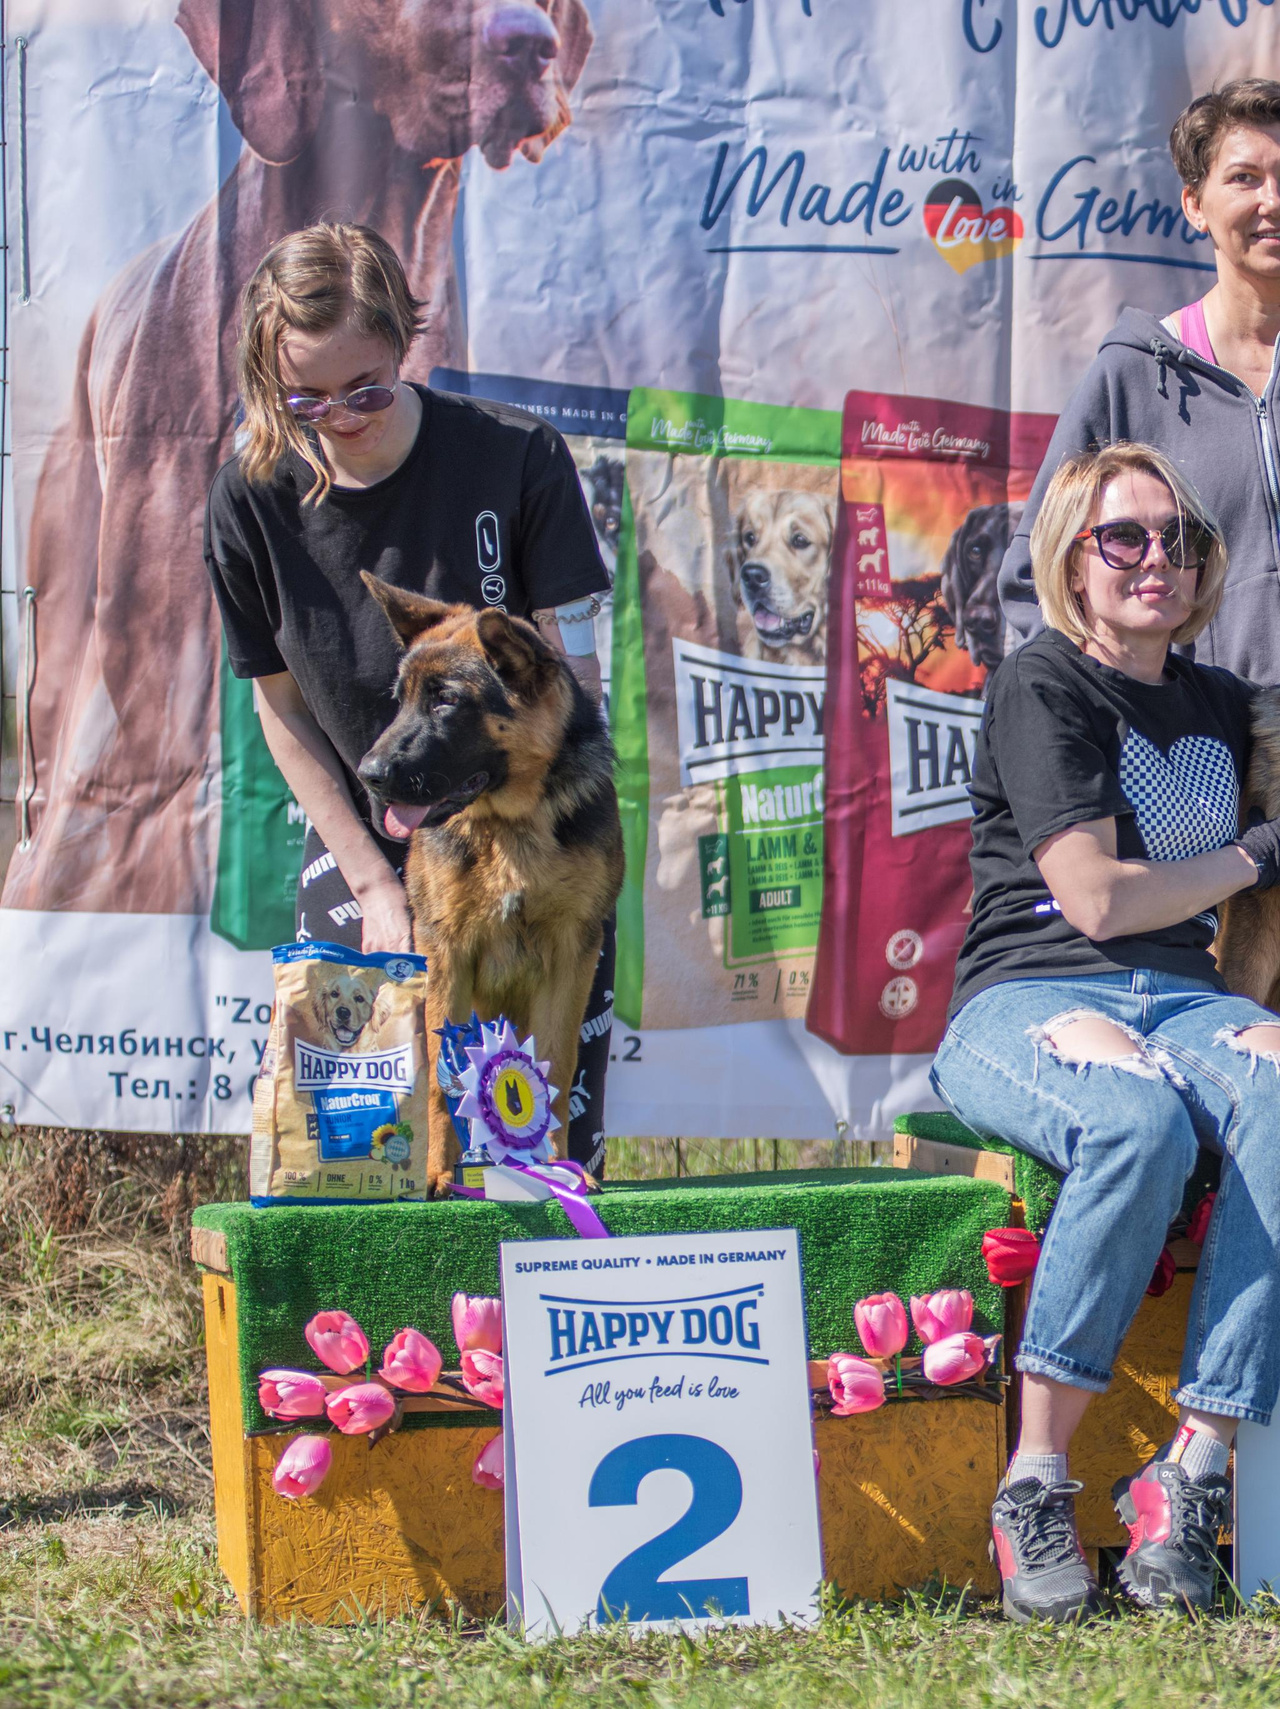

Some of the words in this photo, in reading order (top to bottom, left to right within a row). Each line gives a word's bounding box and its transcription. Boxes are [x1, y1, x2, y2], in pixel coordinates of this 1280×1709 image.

[899, 128, 982, 174] with
[701, 141, 911, 232] Made
[992, 174, 1024, 202] in
[935, 203, 1010, 250] Love
[562, 407, 596, 419] MADE
[602, 411, 614, 421] IN
[901, 420, 920, 431] with
[651, 417, 692, 440] Made
[718, 425, 772, 453] Germany
[861, 420, 906, 443] Made
[907, 432, 931, 452] Love
[932, 427, 989, 458] Germany
[689, 676, 825, 748] HAPPY
[903, 715, 980, 796] HA
[746, 835, 797, 862] LAMM
[803, 832, 818, 855] &
[759, 889, 793, 908] ADULT
[734, 974, 746, 989] 71
[748, 972, 760, 988] %
[789, 970, 797, 985] 0
[800, 971, 810, 984] %
[3, 1026, 236, 1065] г.Челябинск,
[300, 1051, 362, 1079] HAPPY
[365, 1056, 407, 1081] DOG
[108, 1072, 197, 1100] Тел.:
[213, 1073, 232, 1101] 8
[320, 1093, 381, 1111] NaturCroq
[284, 1171, 297, 1180] 100
[326, 1174, 347, 1183] OHNE
[515, 1259, 578, 1273] SUPREME
[581, 1257, 641, 1271] QUALITY
[656, 1254, 697, 1267] MADE
[699, 1253, 714, 1265] IN
[717, 1249, 787, 1264] GERMANY
[546, 1306, 674, 1361] HAPPY
[680, 1299, 761, 1350] DOG
[579, 1380, 611, 1408] All
[614, 1386, 647, 1411] you
[649, 1375, 686, 1400] feed
[689, 1382, 703, 1398] is
[708, 1376, 740, 1400] love
[588, 1433, 751, 1626] 2
